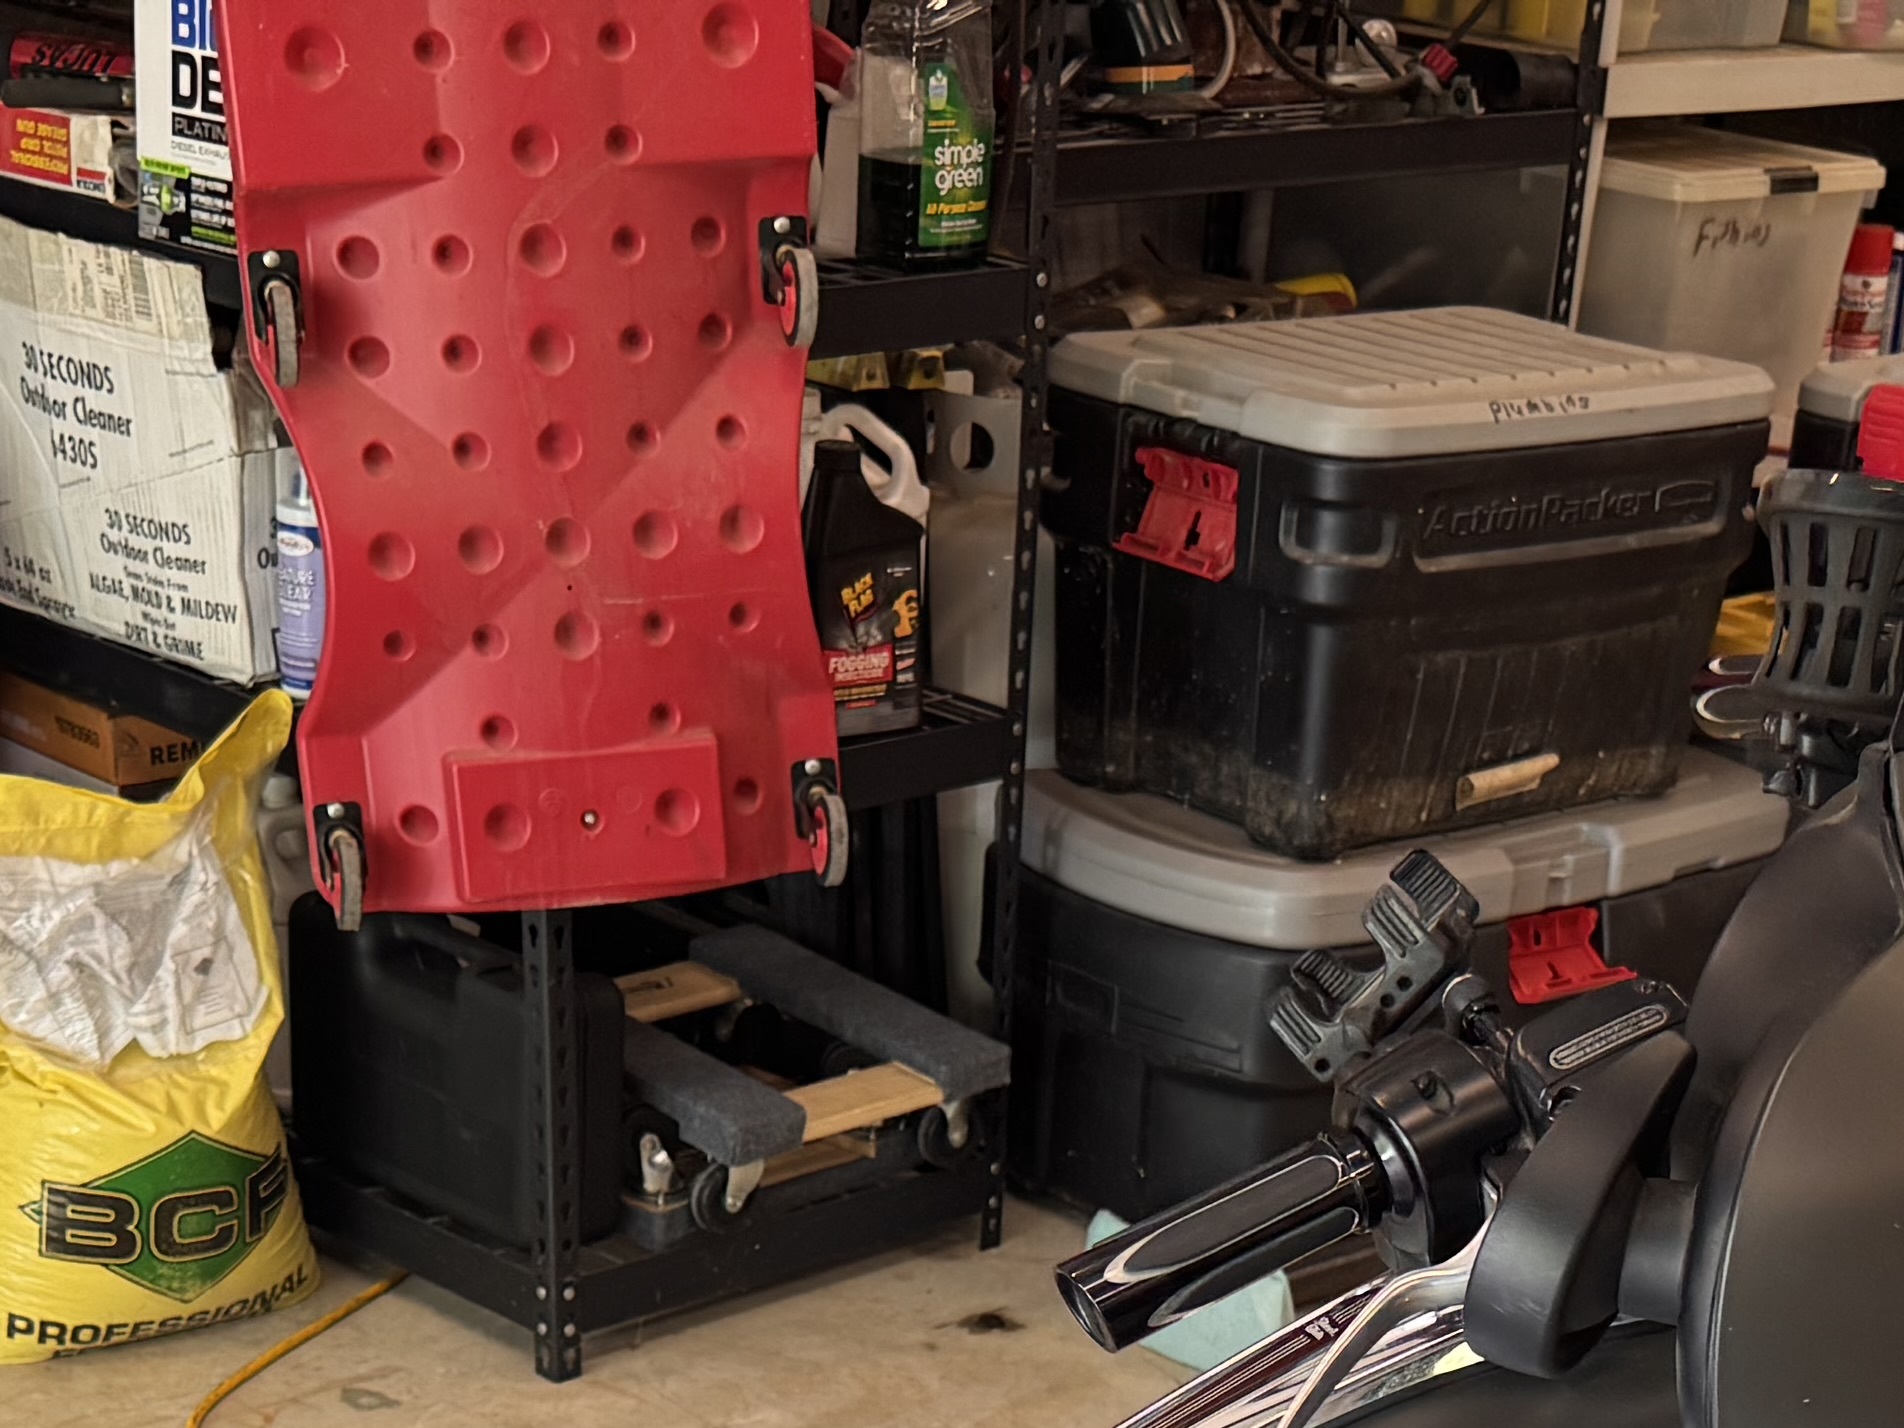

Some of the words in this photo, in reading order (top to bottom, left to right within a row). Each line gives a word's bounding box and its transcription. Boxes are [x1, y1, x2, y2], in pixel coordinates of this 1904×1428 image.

[172, 49, 224, 116] DE
[173, 115, 228, 142] PLATIN
[934, 138, 986, 168] simple
[934, 165, 984, 196] green
[38, 349, 115, 395] SECONDS
[72, 396, 133, 438] Cleaner
[124, 512, 192, 546] SECONDS
[151, 546, 208, 576] Cleaner
[180, 596, 238, 625] MILDEW
[6, 1263, 309, 1349] PROFESSIONAL
